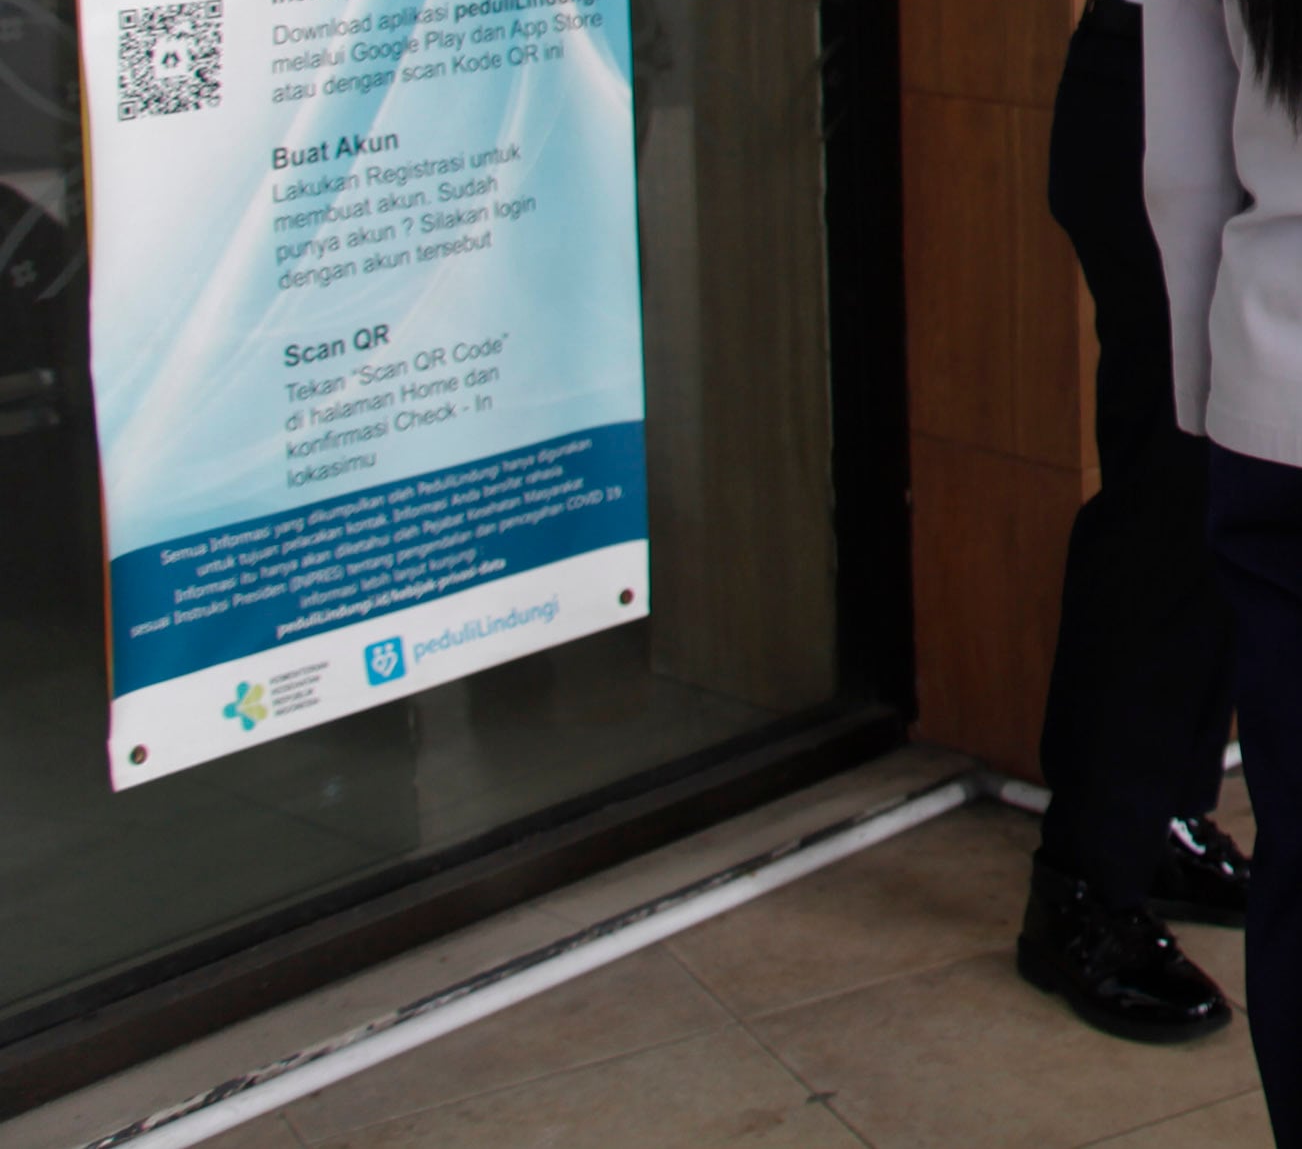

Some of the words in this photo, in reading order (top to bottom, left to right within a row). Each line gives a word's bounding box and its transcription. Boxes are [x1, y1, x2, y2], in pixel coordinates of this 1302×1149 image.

[272, 13, 372, 46] Download
[378, 5, 448, 32] aplikasi
[272, 46, 346, 75] melalui
[352, 36, 420, 63] Google
[425, 29, 466, 52] Play
[471, 23, 506, 45] dan
[510, 18, 548, 40] App
[553, 11, 603, 33] Store
[272, 82, 317, 104] atau
[323, 70, 396, 95] dengan
[402, 61, 447, 82] scan
[452, 50, 502, 74] Kode
[507, 44, 539, 66] QR
[544, 39, 565, 60] ini
[272, 141, 330, 170] Buat
[335, 132, 399, 159] Akun
[272, 173, 360, 203] Lakukan
[366, 152, 465, 187] Registrasi
[470, 143, 521, 169] untuk
[273, 198, 372, 233] membuat
[377, 189, 432, 214] akun.
[438, 175, 498, 202] Sudah
[276, 234, 341, 266] punya
[347, 224, 396, 248] akun
[402, 217, 414, 236] ?
[420, 204, 489, 234] Silakan
[494, 194, 537, 221] login
[278, 259, 357, 290] dengan
[363, 249, 411, 274] akun
[416, 231, 493, 262] tersebut
[284, 337, 346, 368] Scan
[353, 323, 390, 352] QR
[285, 374, 346, 403] Tekan
[414, 347, 447, 372] QR
[285, 410, 304, 433] di
[310, 390, 395, 426] halaman
[401, 376, 460, 403] Home
[464, 364, 500, 389] dan
[286, 420, 389, 460] konfirmasi
[394, 401, 457, 432] Check
[475, 393, 493, 413] In
[287, 451, 377, 490] lokasimu
[413, 594, 560, 663] peduliLindungi
